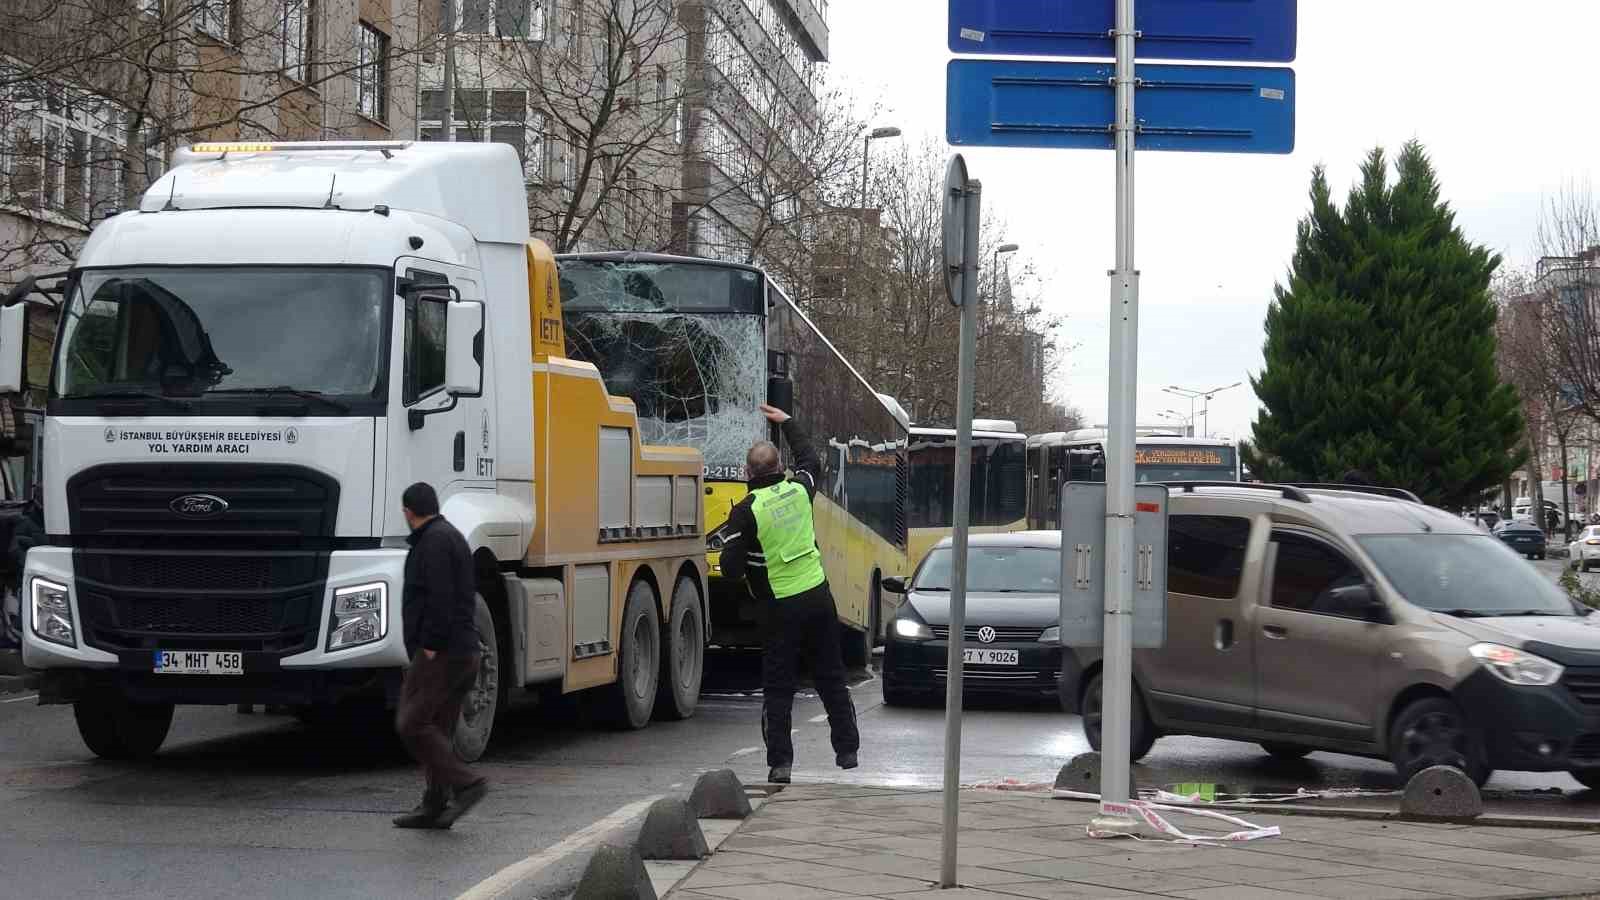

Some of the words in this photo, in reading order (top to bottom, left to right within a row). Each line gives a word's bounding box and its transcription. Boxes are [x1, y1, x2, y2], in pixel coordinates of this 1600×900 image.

[539, 311, 561, 341] İETT
[119, 430, 164, 441] İSTANBUL
[166, 430, 226, 442] BÜYÜKŞEHİR
[227, 430, 282, 442] BELEDİYESİ
[148, 443, 169, 454] YOL
[171, 443, 213, 454] YARDIM
[216, 443, 249, 454] ARACI
[476, 451, 494, 477] İETT
[181, 497, 214, 513] Ford
[161, 652, 179, 668] 34
[185, 652, 209, 669] MHT
[215, 653, 241, 669] 458
[978, 651, 985, 662] Y
[989, 651, 1017, 663] 9026
